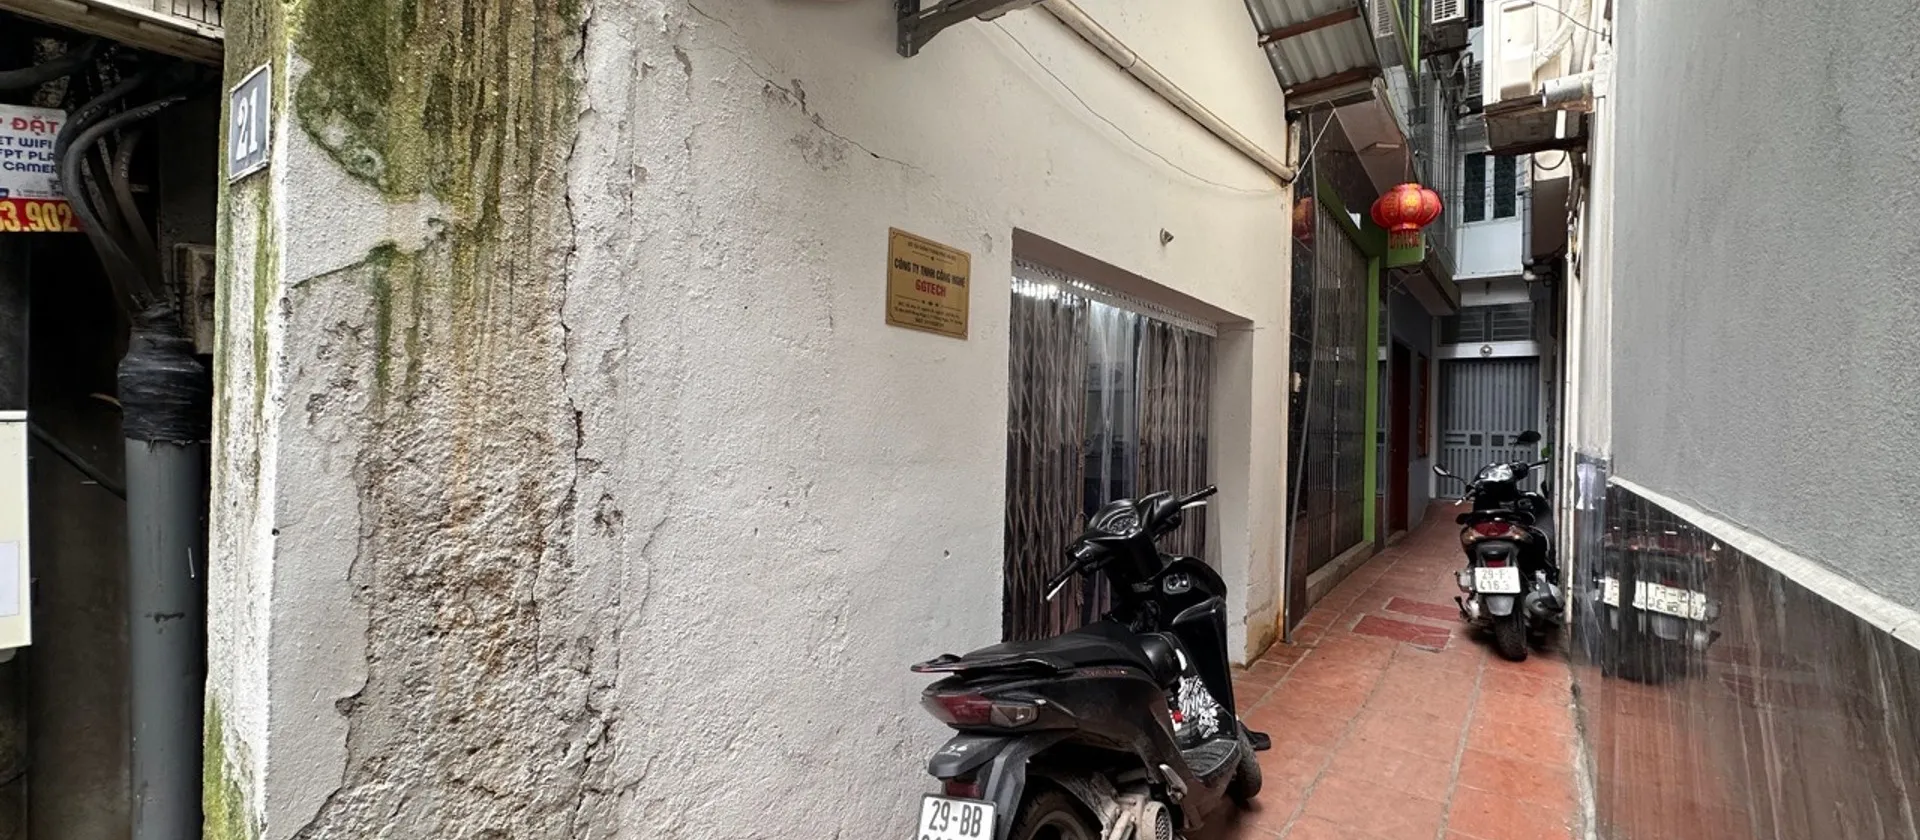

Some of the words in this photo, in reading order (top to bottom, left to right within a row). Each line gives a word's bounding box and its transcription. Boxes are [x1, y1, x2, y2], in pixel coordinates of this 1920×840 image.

[10, 115, 59, 136] ĐẶT
[236, 86, 258, 161] 21
[18, 136, 52, 149] WIFI
[0, 200, 78, 232] 3.902
[894, 257, 912, 273] CÔNG
[912, 263, 919, 274] TY
[929, 800, 983, 838] 29-BB
